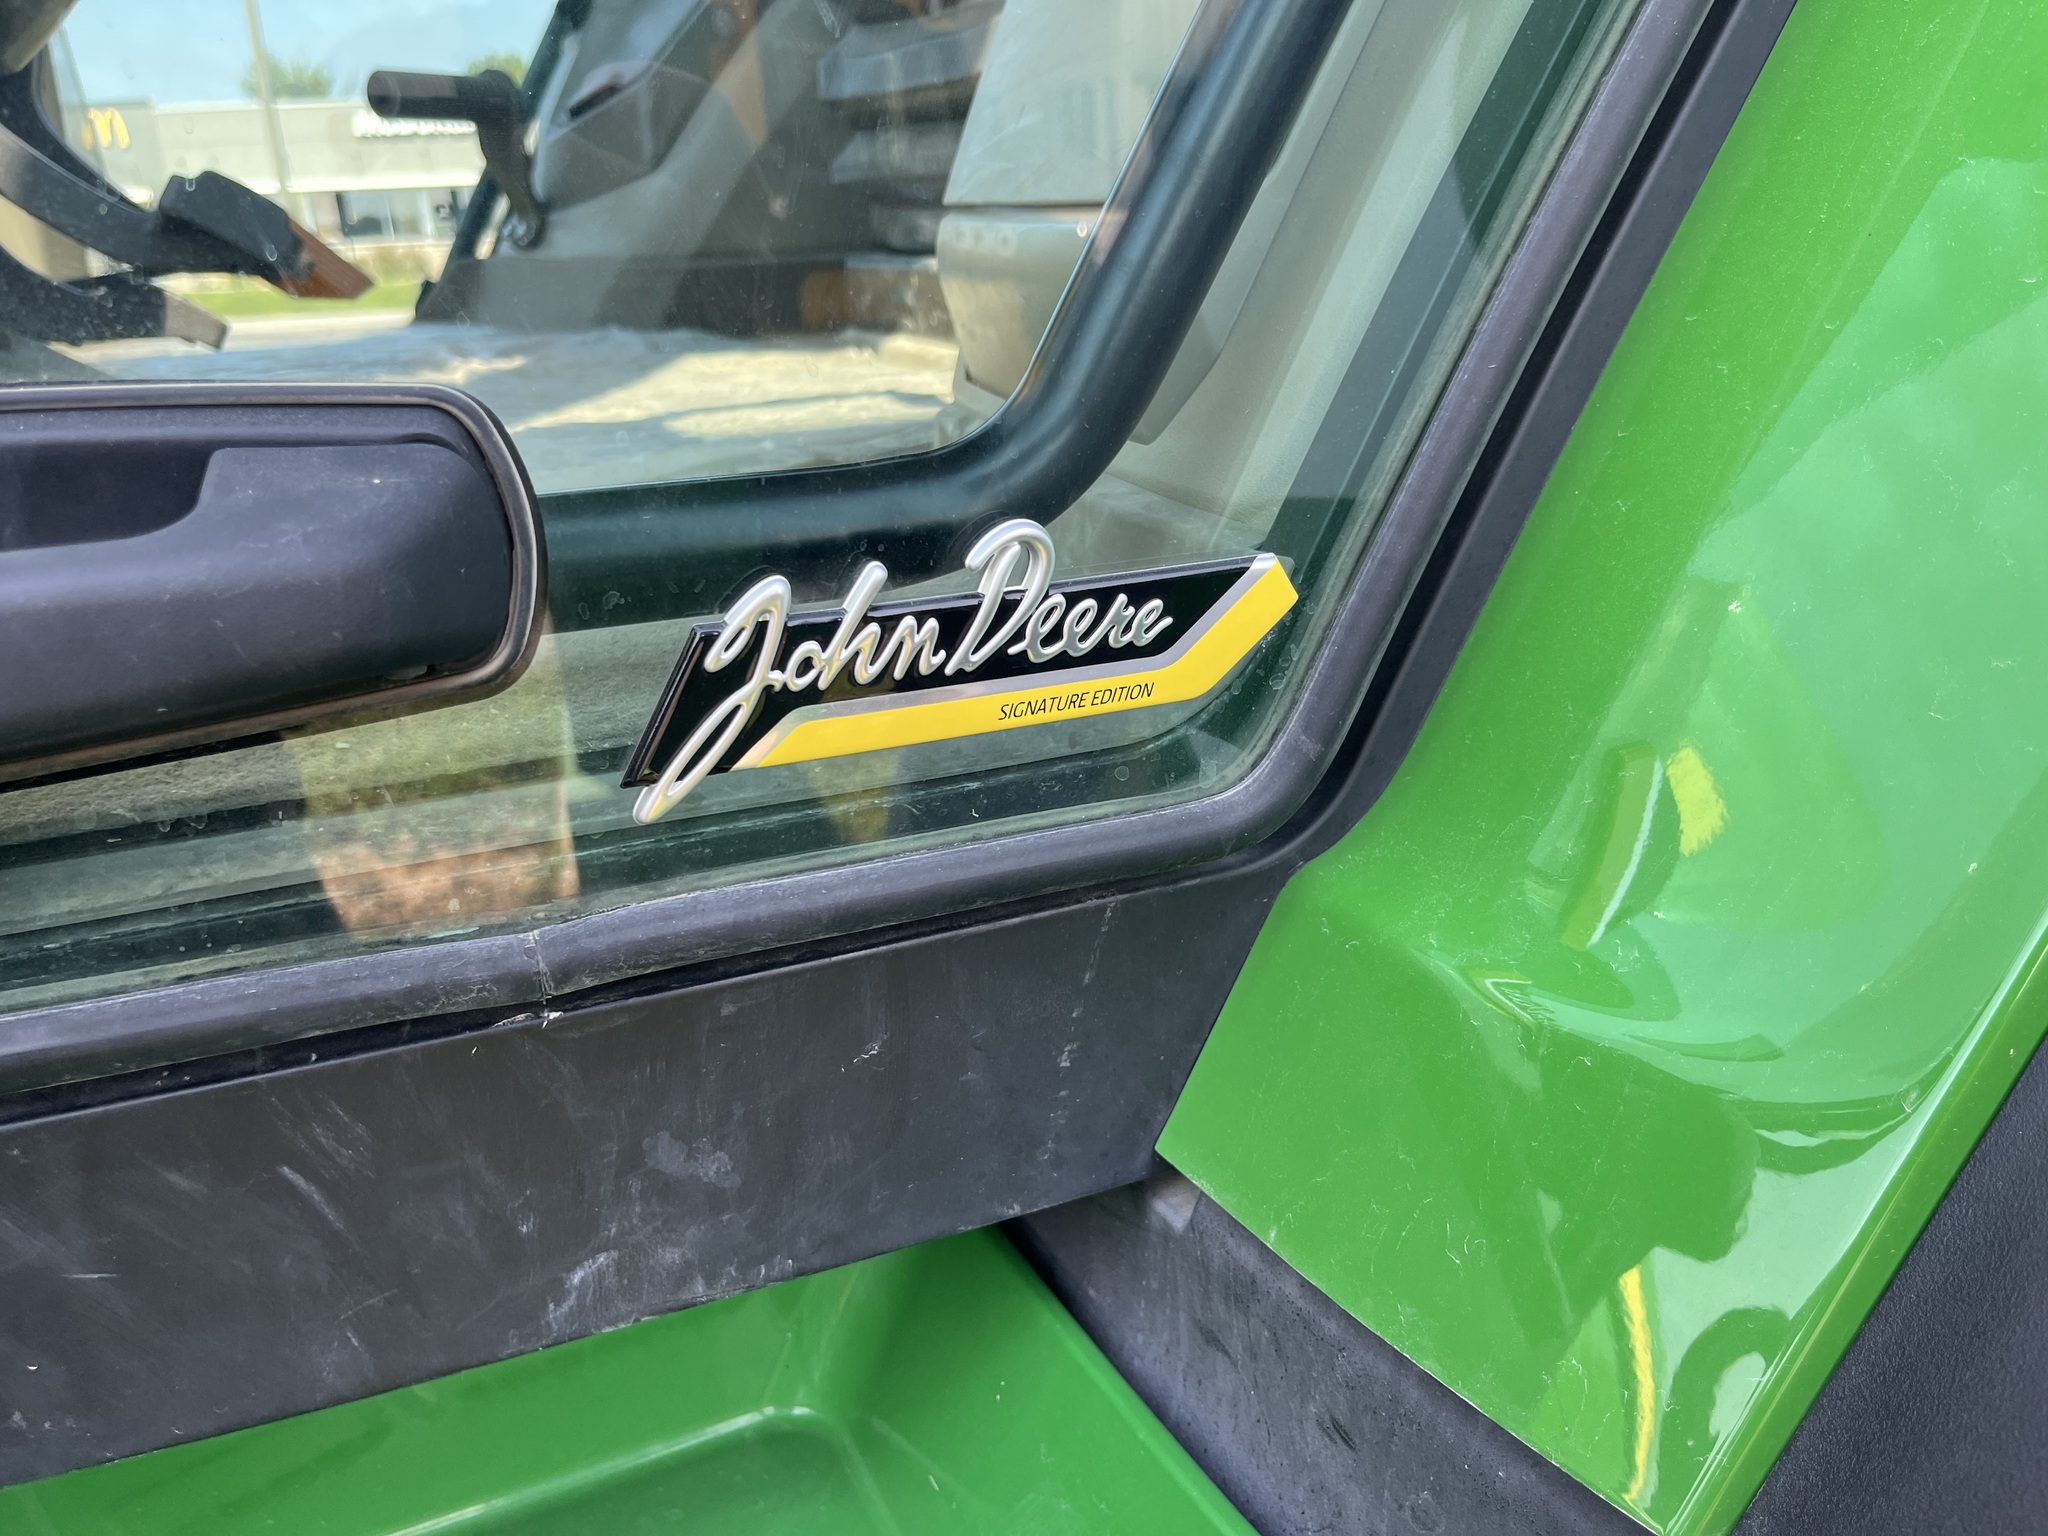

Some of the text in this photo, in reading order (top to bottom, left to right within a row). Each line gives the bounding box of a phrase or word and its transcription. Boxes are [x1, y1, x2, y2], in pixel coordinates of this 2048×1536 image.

[633, 518, 1174, 825] John Deere
[998, 682, 1154, 720] SIGNATURE EDITION
